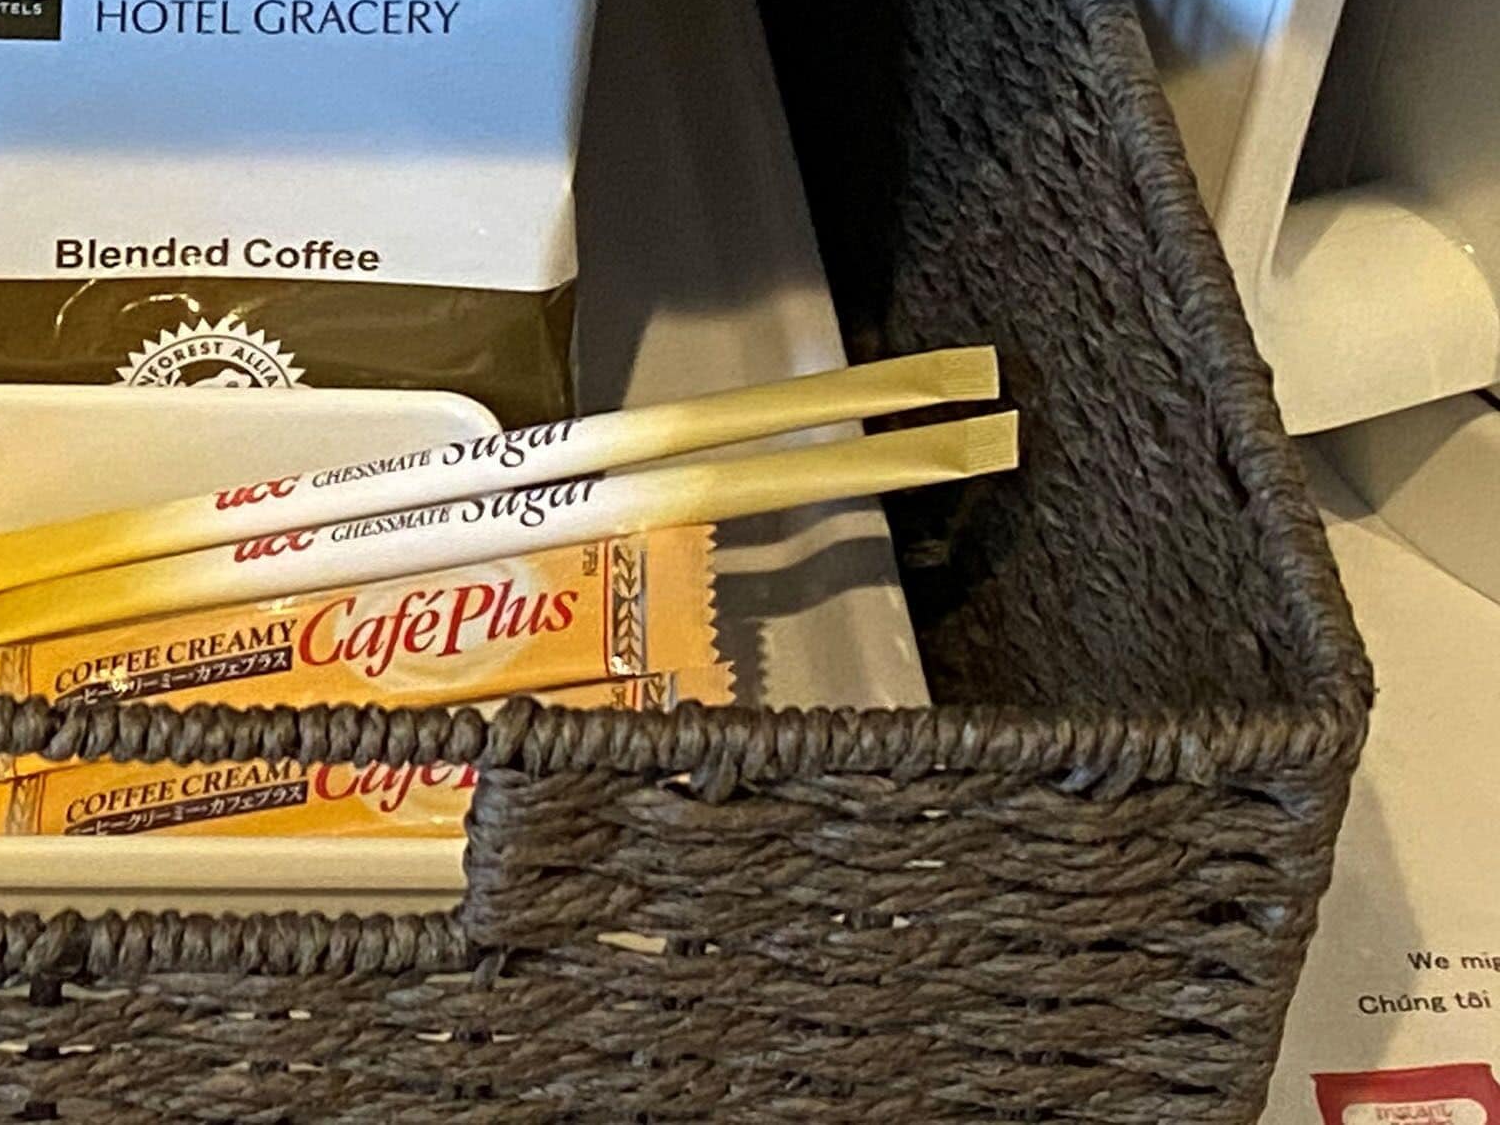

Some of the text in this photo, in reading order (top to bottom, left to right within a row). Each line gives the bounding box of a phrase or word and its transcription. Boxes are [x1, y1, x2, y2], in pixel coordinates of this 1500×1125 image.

[97, 0, 240, 35] HOTEL
[56, 237, 380, 272] Blended Coffee
[312, 448, 432, 488] CHESSMATE
[331, 504, 451, 544] CHESSMATE
[55, 618, 299, 694] COFFEE CREAMY
[66, 778, 176, 824] COFFEE
[1408, 951, 1449, 970] We
[1358, 989, 1492, 1014] Chúng tôi
